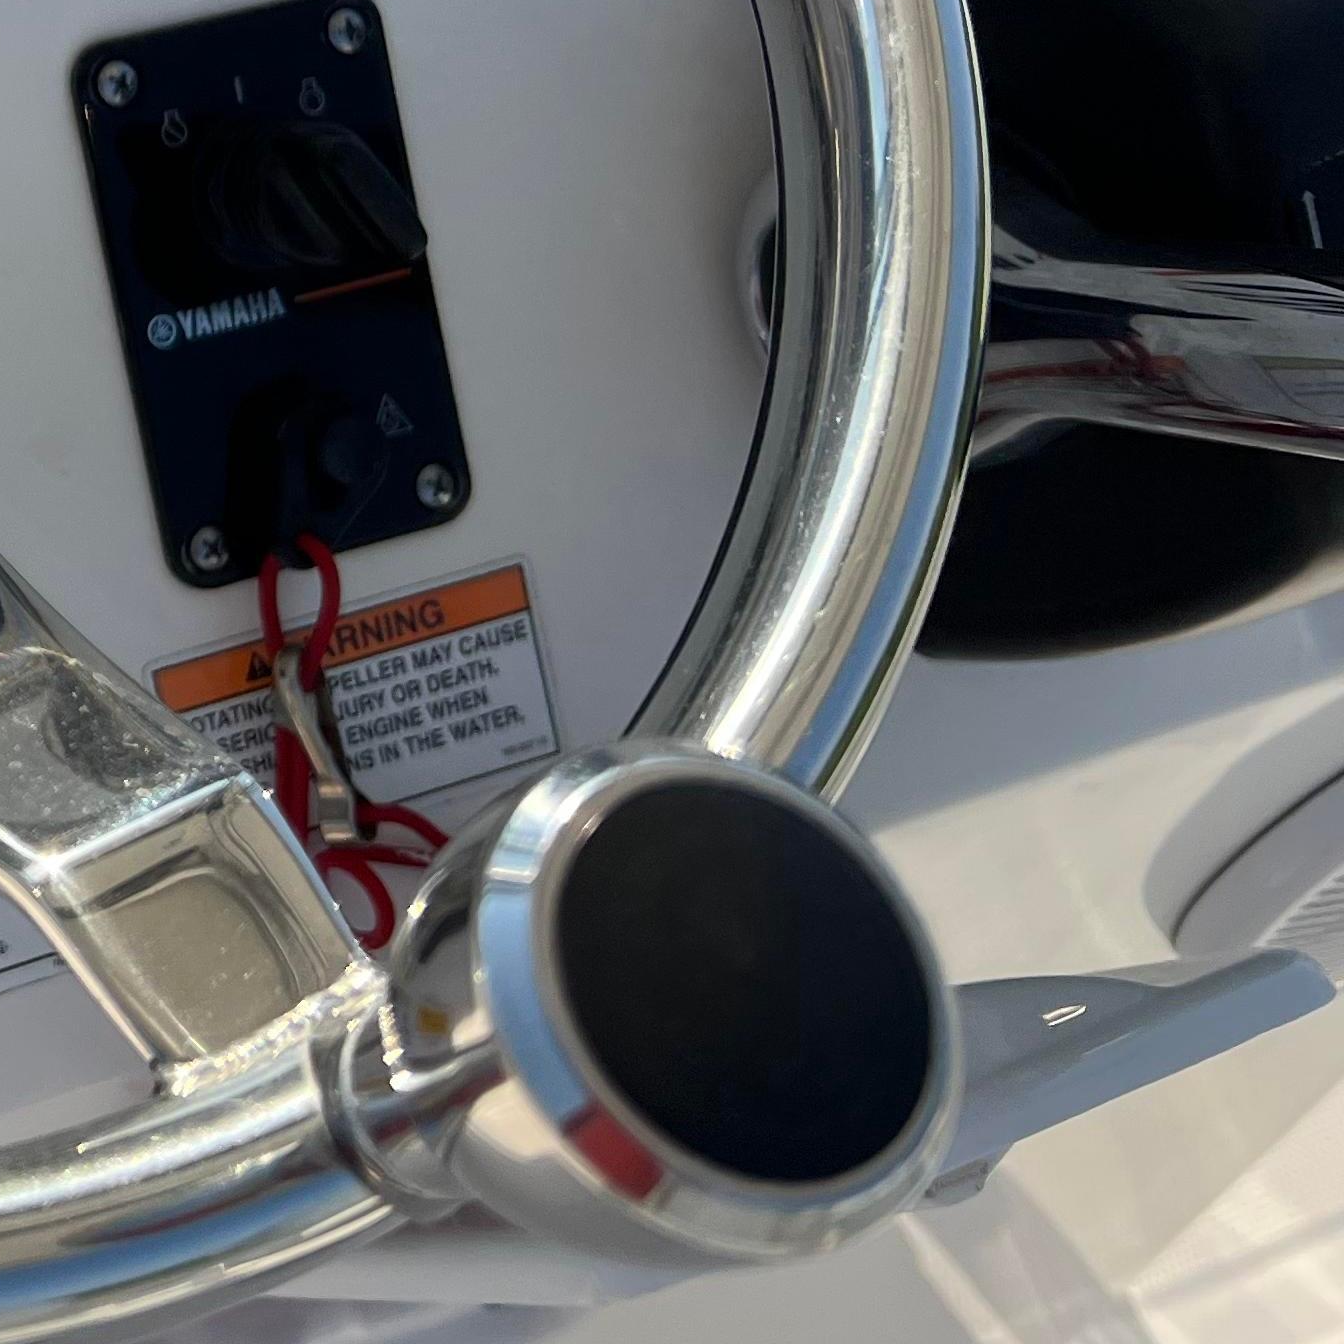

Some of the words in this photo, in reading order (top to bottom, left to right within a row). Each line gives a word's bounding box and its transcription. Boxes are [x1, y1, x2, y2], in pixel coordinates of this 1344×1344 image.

[176, 285, 287, 341] YAMAHA
[325, 599, 445, 658] RNING
[326, 655, 407, 696] PELLER
[412, 639, 453, 669] MAY
[458, 618, 529, 656] CAUSE
[337, 689, 385, 721] JURY
[391, 678, 432, 703] OR
[426, 656, 500, 693] DEATH.
[346, 705, 425, 745] ENGINE
[426, 684, 489, 719] WHEN
[378, 740, 402, 764] IN
[404, 726, 446, 755] THE
[448, 704, 525, 742] WATER.
